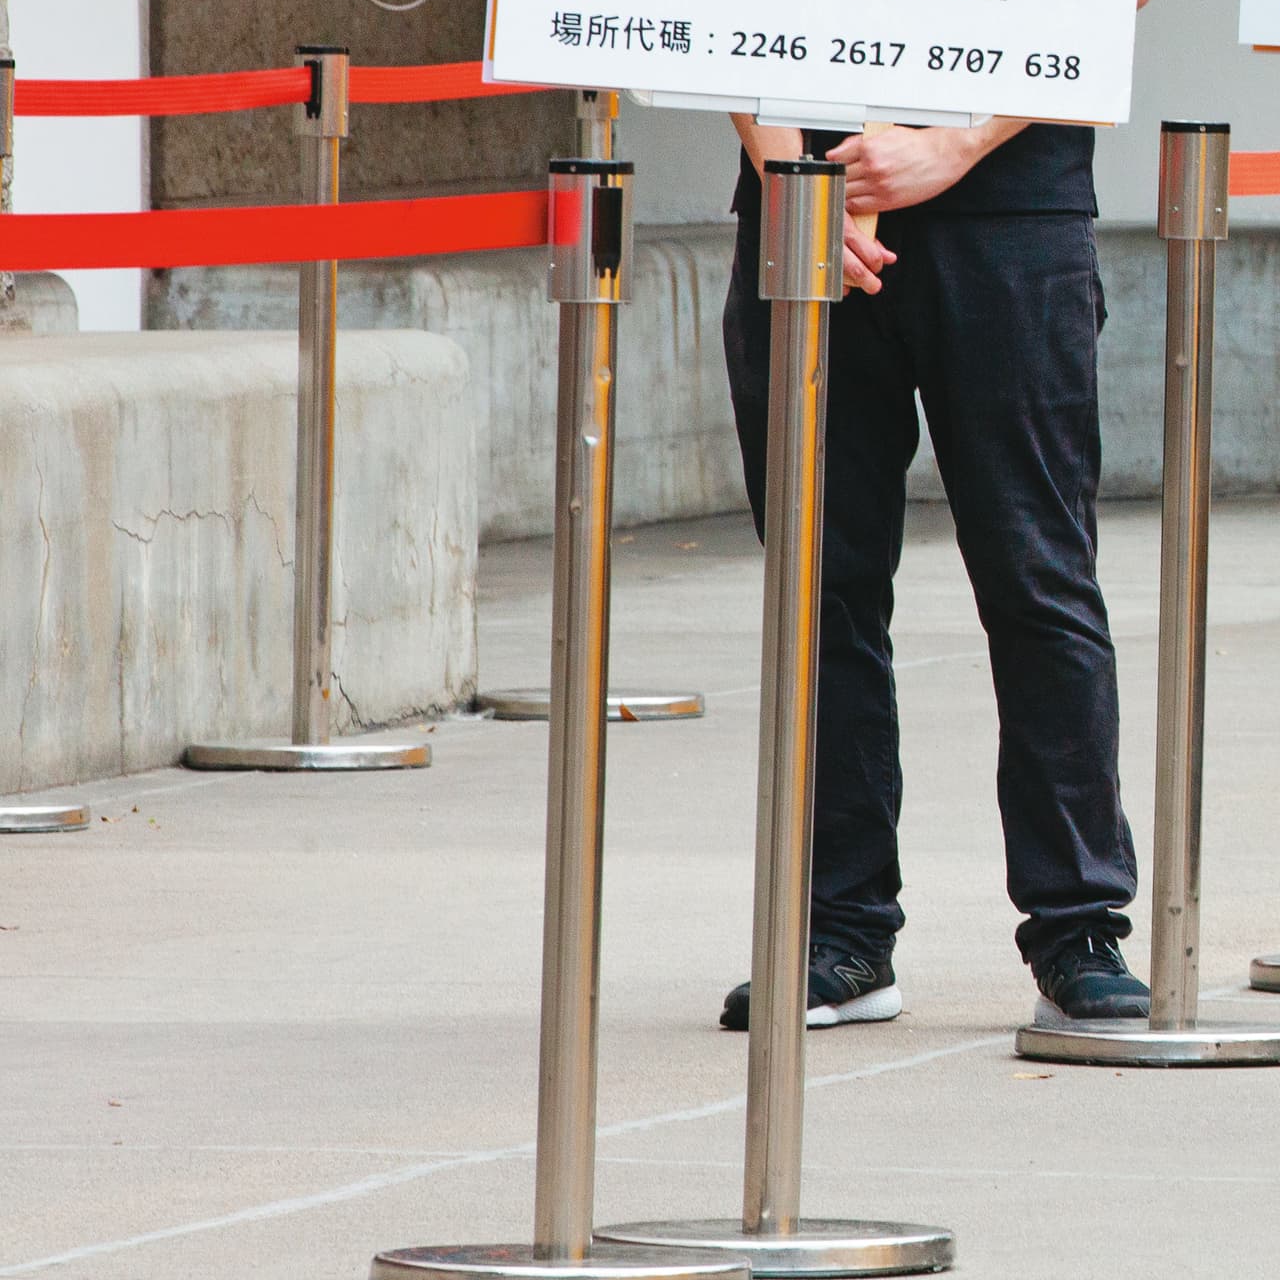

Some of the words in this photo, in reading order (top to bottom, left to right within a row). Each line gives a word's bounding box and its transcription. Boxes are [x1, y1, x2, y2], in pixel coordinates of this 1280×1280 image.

[730, 31, 807, 61] 2246
[829, 38, 906, 67] 2617
[927, 45, 1004, 74] 8707
[1025, 53, 1081, 81] 638
